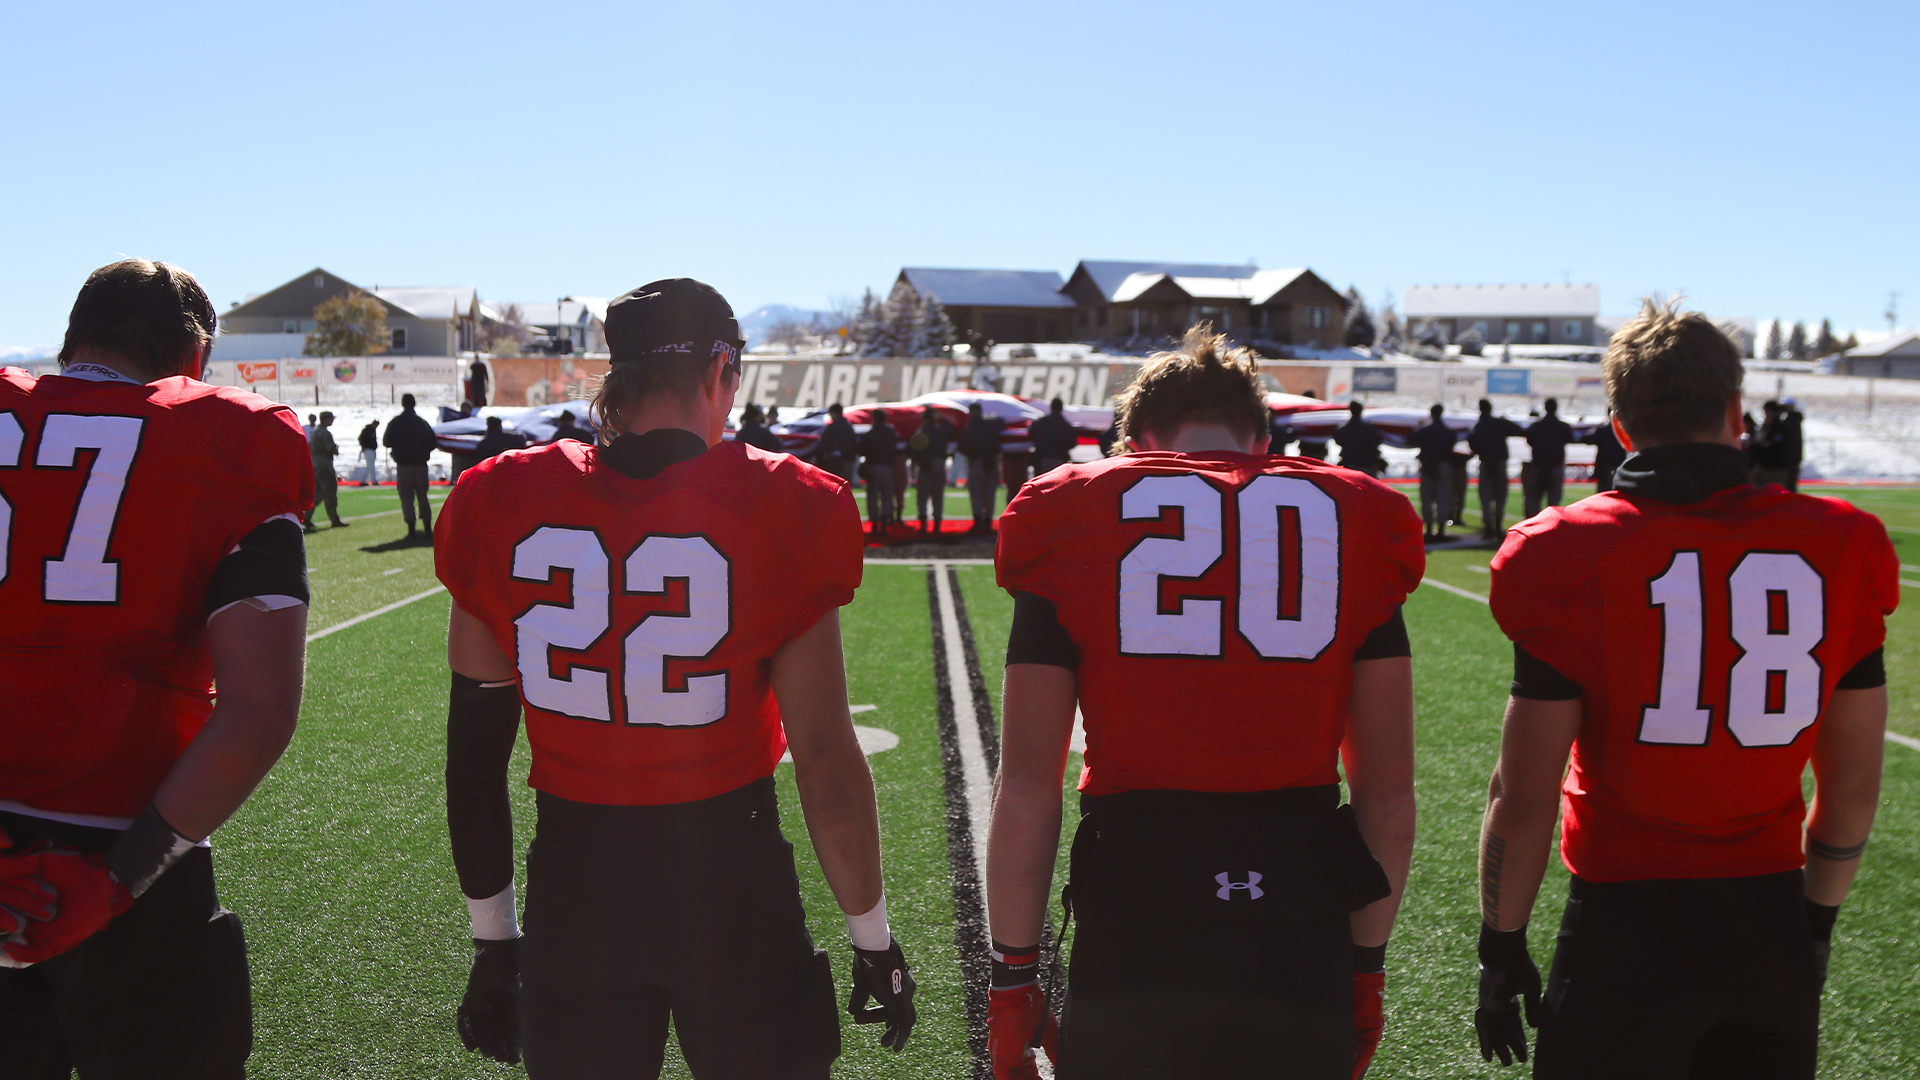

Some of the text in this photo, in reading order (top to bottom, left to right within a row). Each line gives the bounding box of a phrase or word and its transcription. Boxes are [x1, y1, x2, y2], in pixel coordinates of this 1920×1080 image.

[89, 366, 118, 379] PRO
[292, 368, 314, 379] ACE
[795, 364, 883, 408] ARE
[0, 408, 148, 606] 7
[1116, 472, 1342, 663] 20
[509, 522, 734, 728] 22
[1634, 548, 1827, 748] 18
